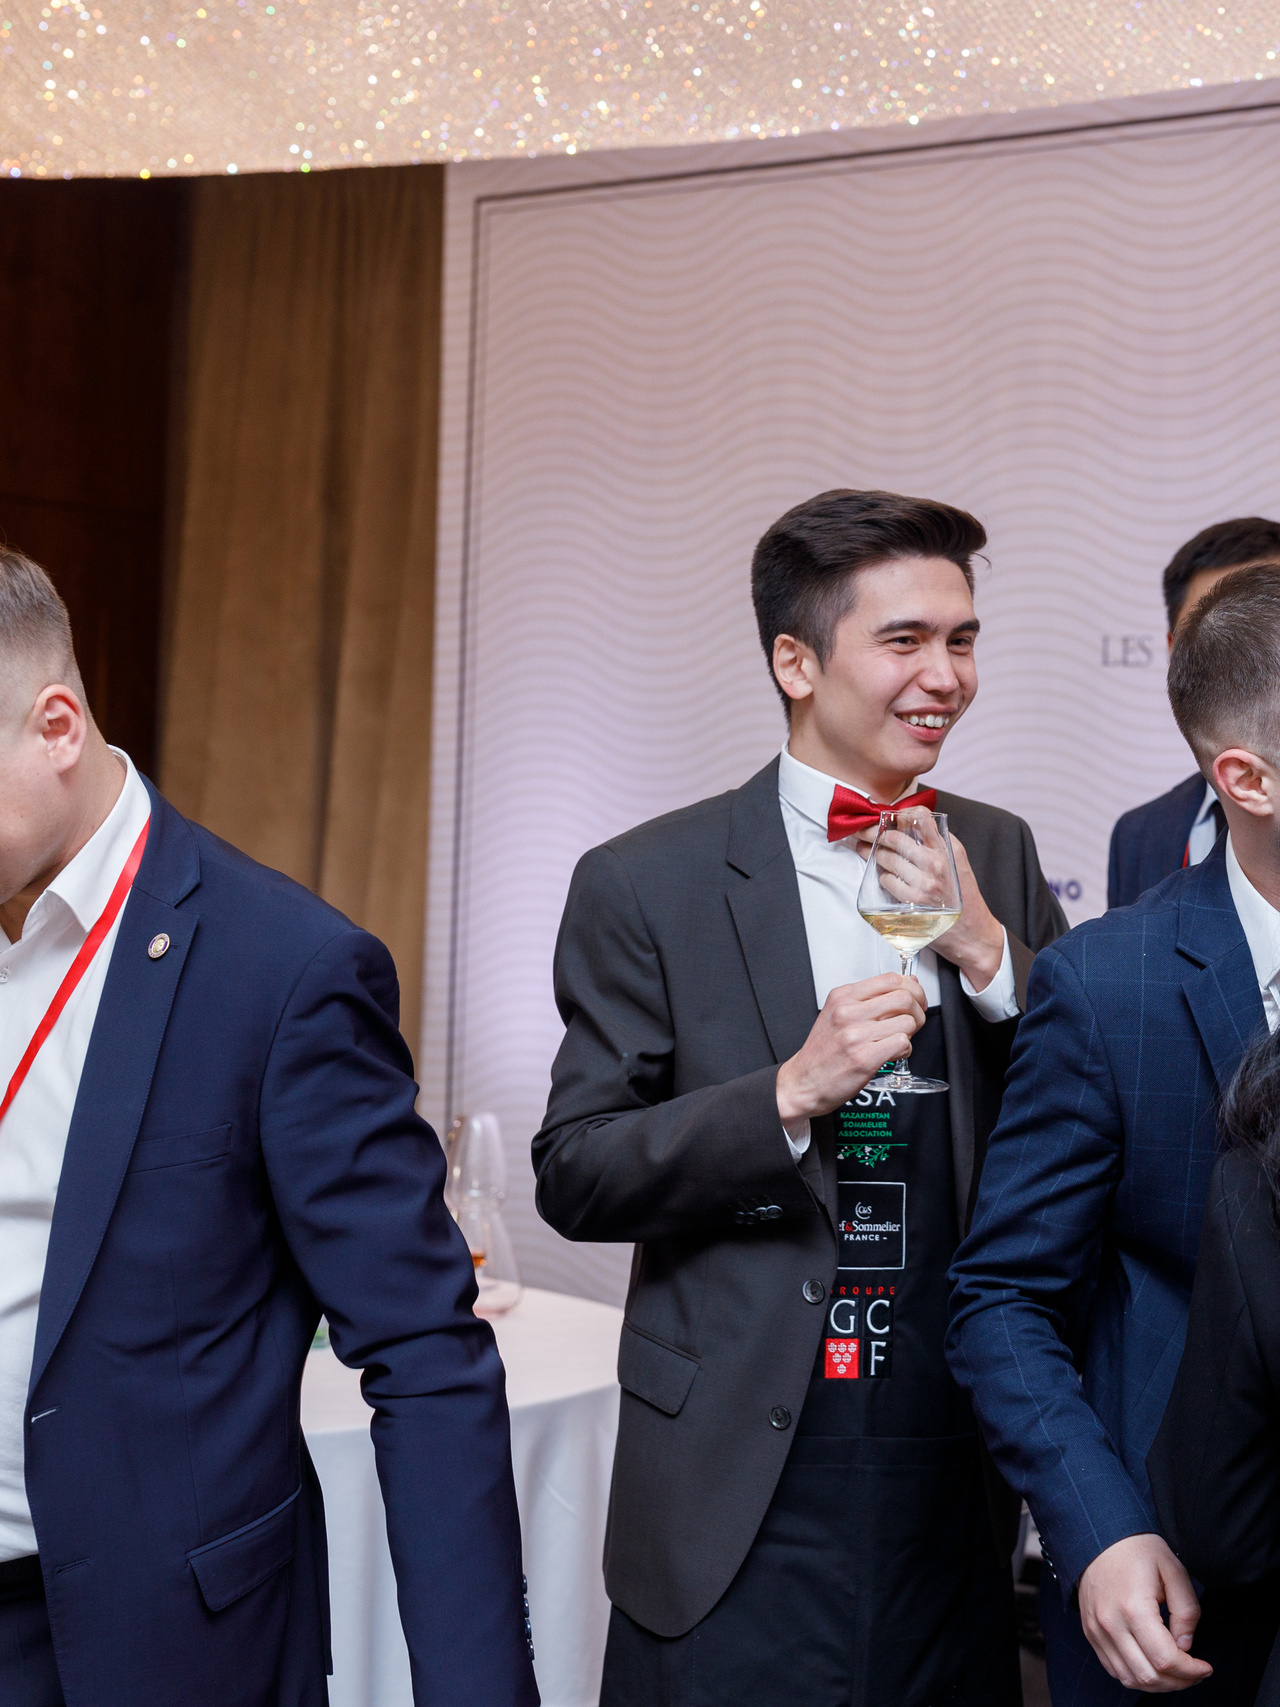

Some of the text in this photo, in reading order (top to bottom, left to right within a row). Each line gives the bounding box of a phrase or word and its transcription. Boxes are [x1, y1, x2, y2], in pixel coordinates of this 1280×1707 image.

[1101, 633, 1156, 668] LES
[845, 1088, 897, 1107] SA
[839, 1111, 891, 1120] KAZAKHSTAN
[842, 1120, 888, 1129] SOMMELIER
[837, 1129, 893, 1138] ASSOCIATION
[830, 1285, 895, 1296] ROUPE
